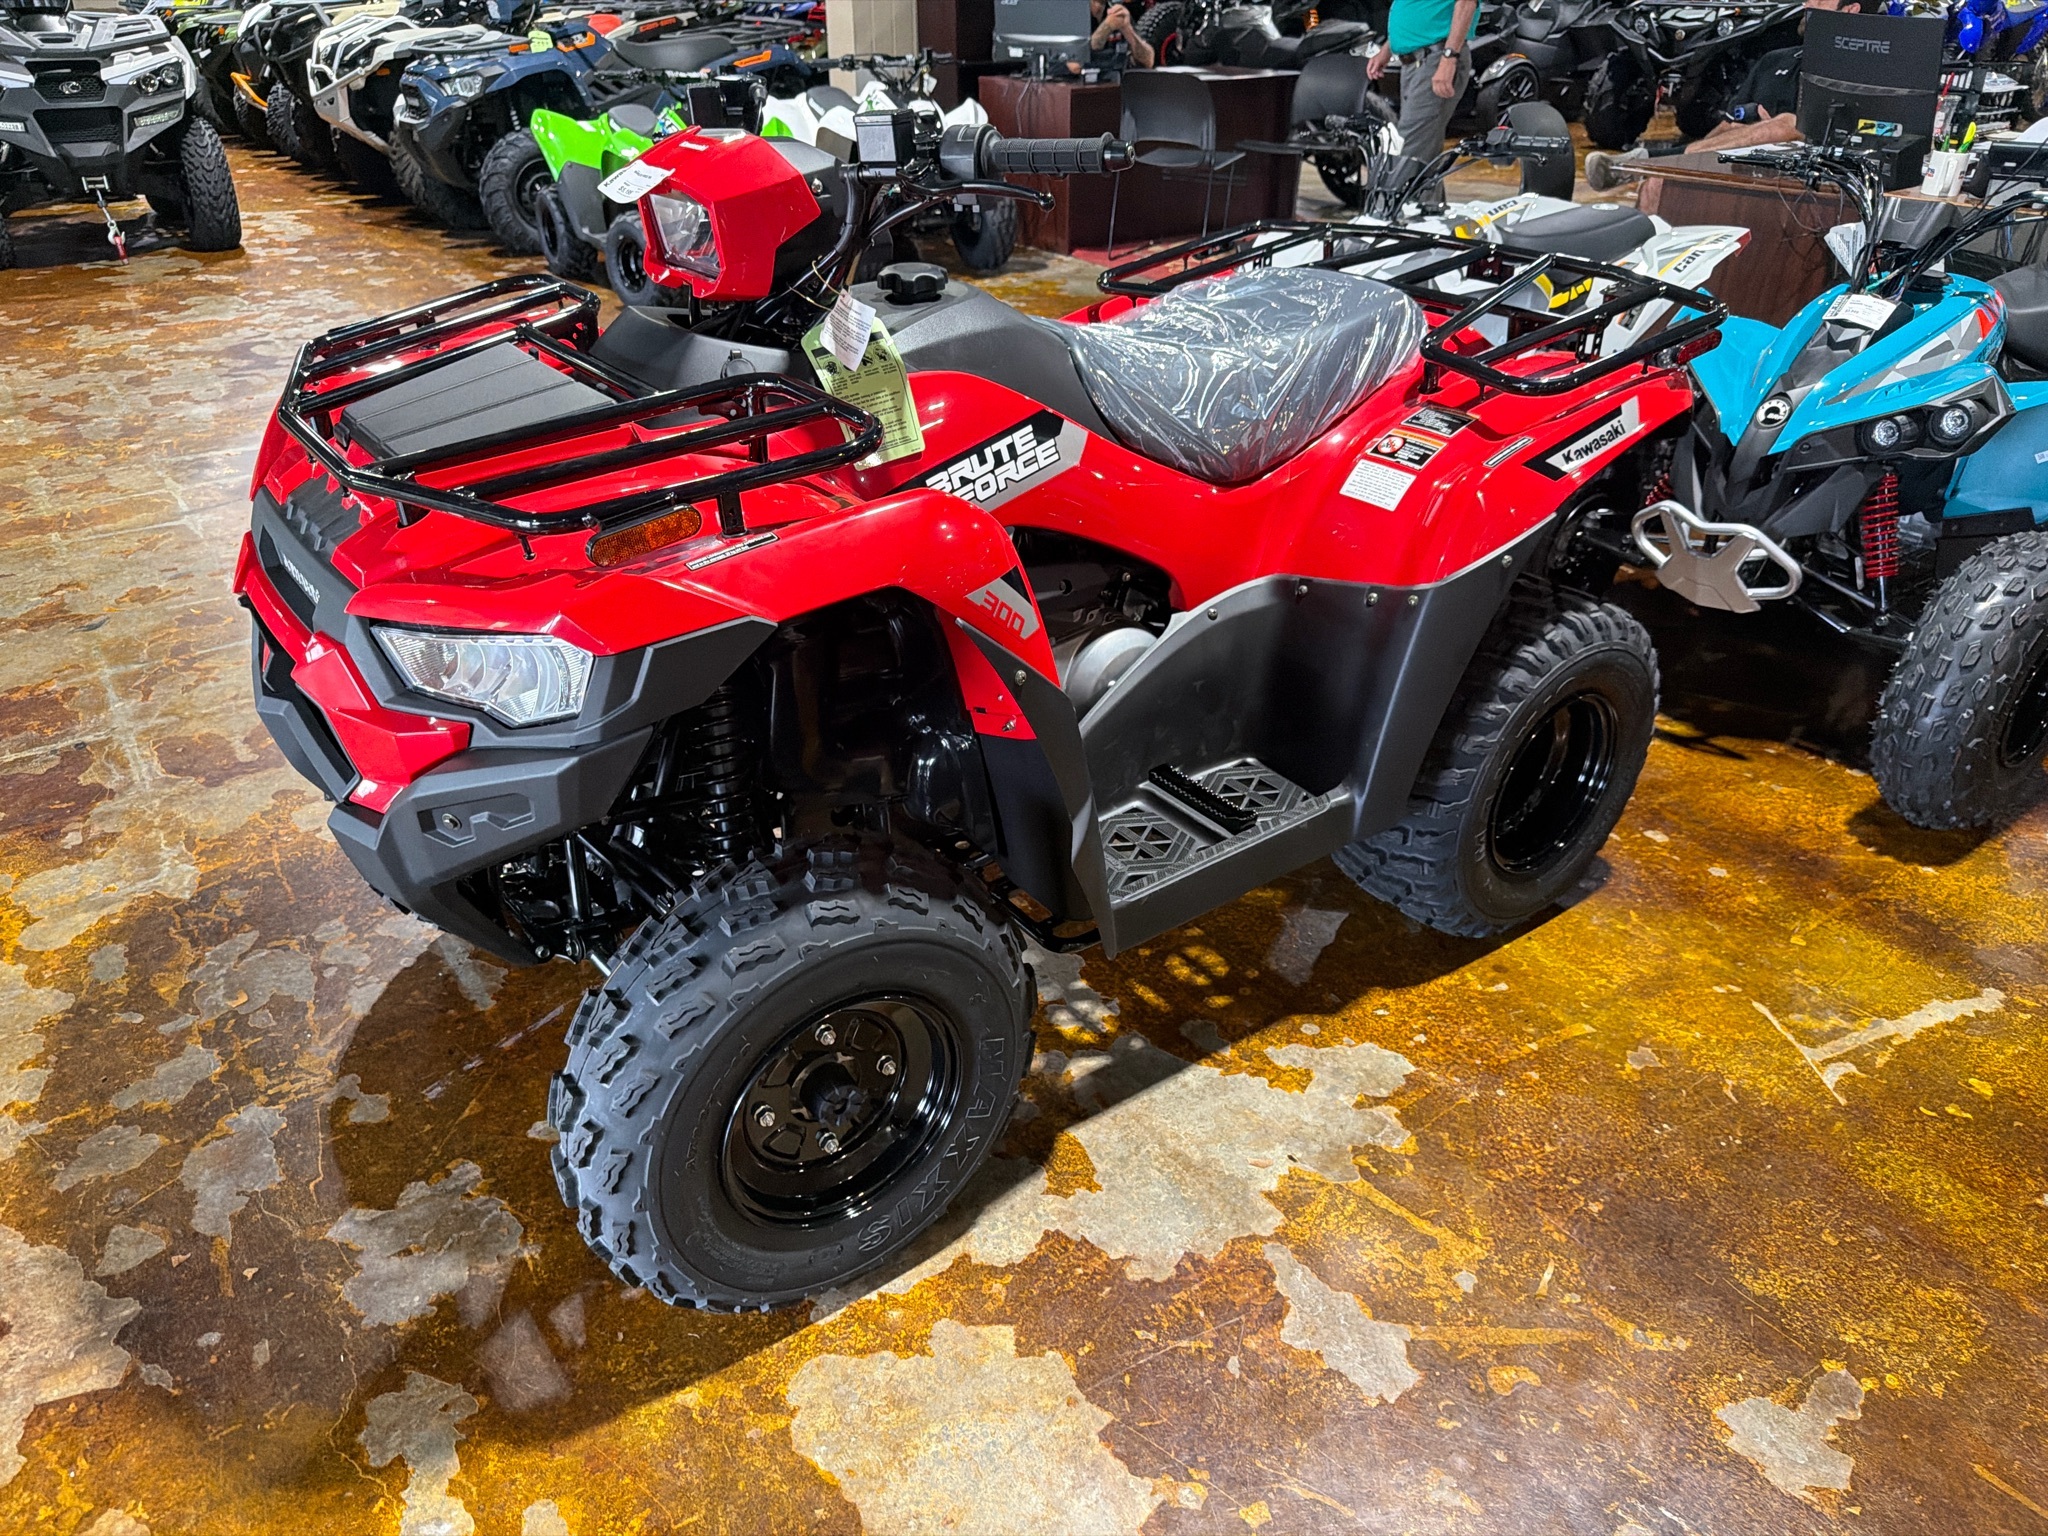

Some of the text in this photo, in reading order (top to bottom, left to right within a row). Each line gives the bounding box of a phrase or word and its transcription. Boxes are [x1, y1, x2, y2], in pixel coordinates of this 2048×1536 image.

[1834, 36, 1891, 54] SCEPTRE
[925, 424, 1038, 494] BRUTE
[951, 438, 1060, 502] FORCE
[1561, 420, 1626, 465] Kawasaki
[981, 589, 1025, 636] 300
[857, 1038, 1006, 1250] MAXXIS
